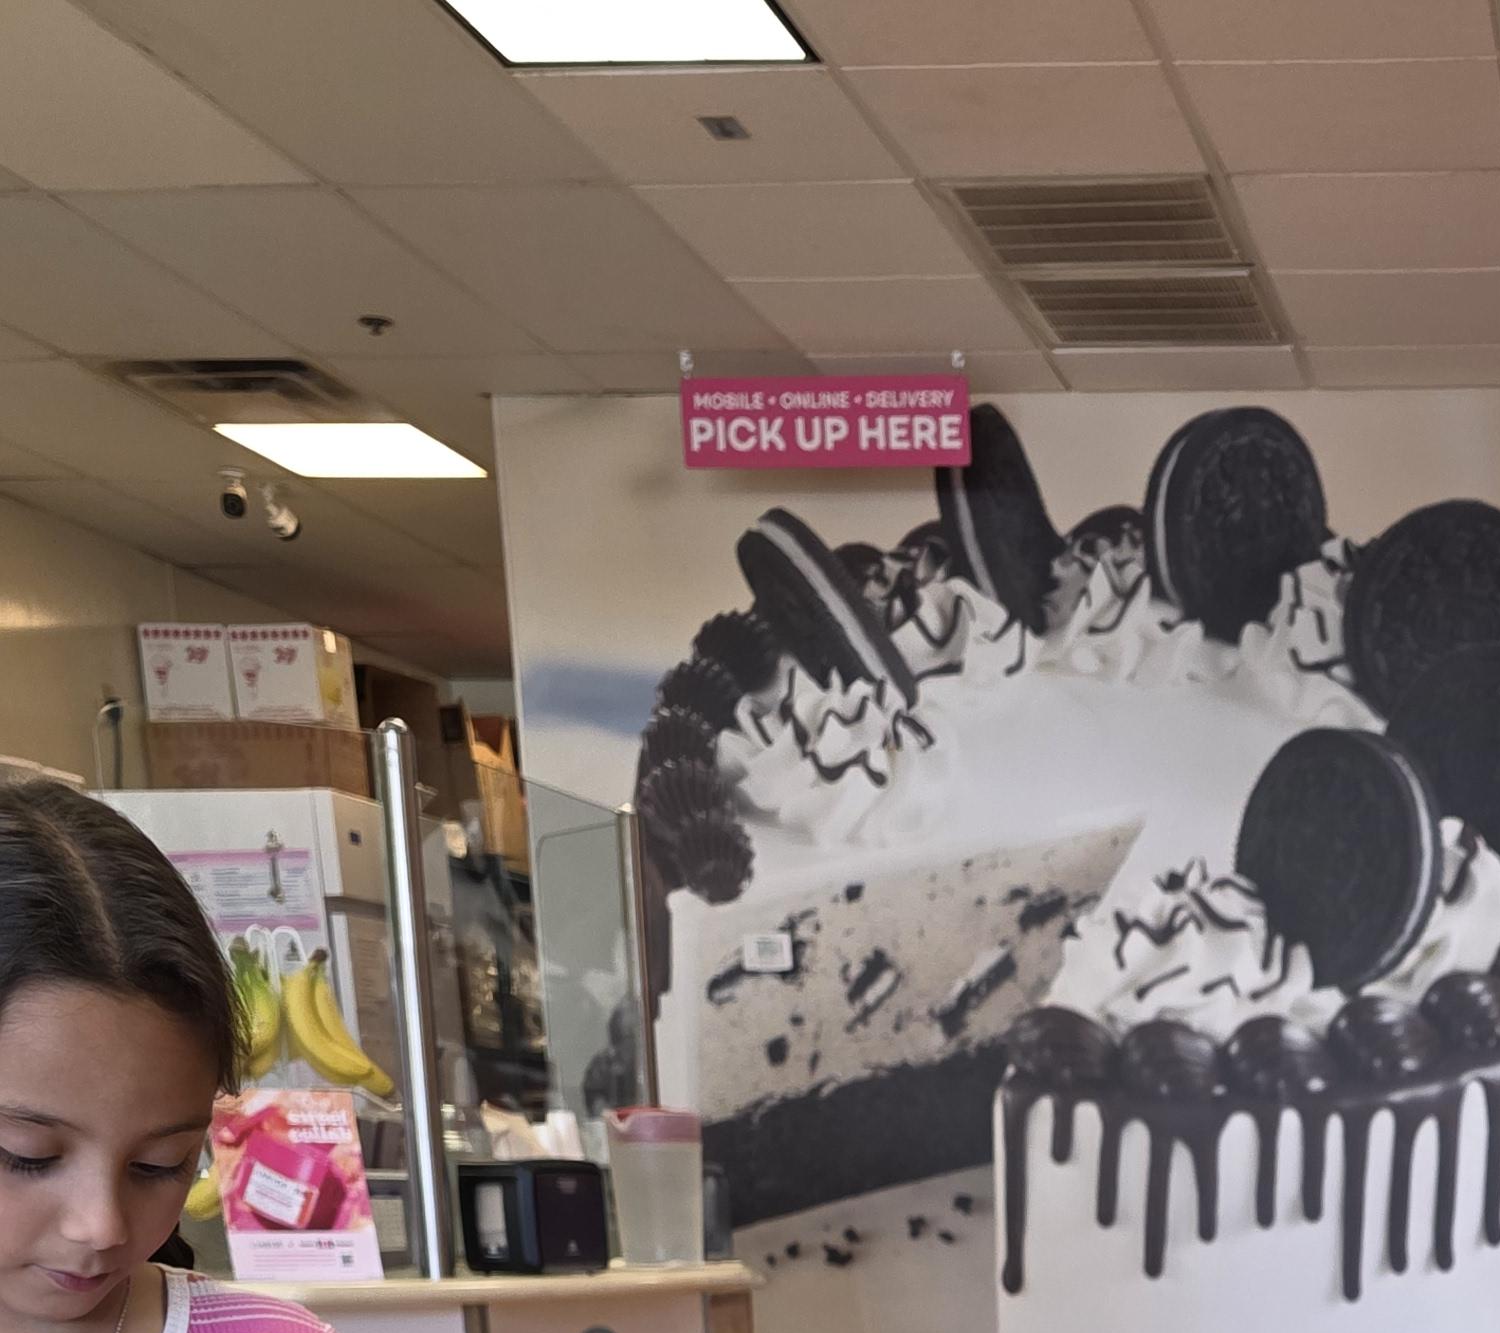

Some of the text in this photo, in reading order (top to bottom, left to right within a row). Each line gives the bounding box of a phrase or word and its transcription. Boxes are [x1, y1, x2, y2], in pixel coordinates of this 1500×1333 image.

[693, 389, 954, 411] MOBILE ONLINE DELIVERY
[689, 413, 964, 452] PICK UP HERE
